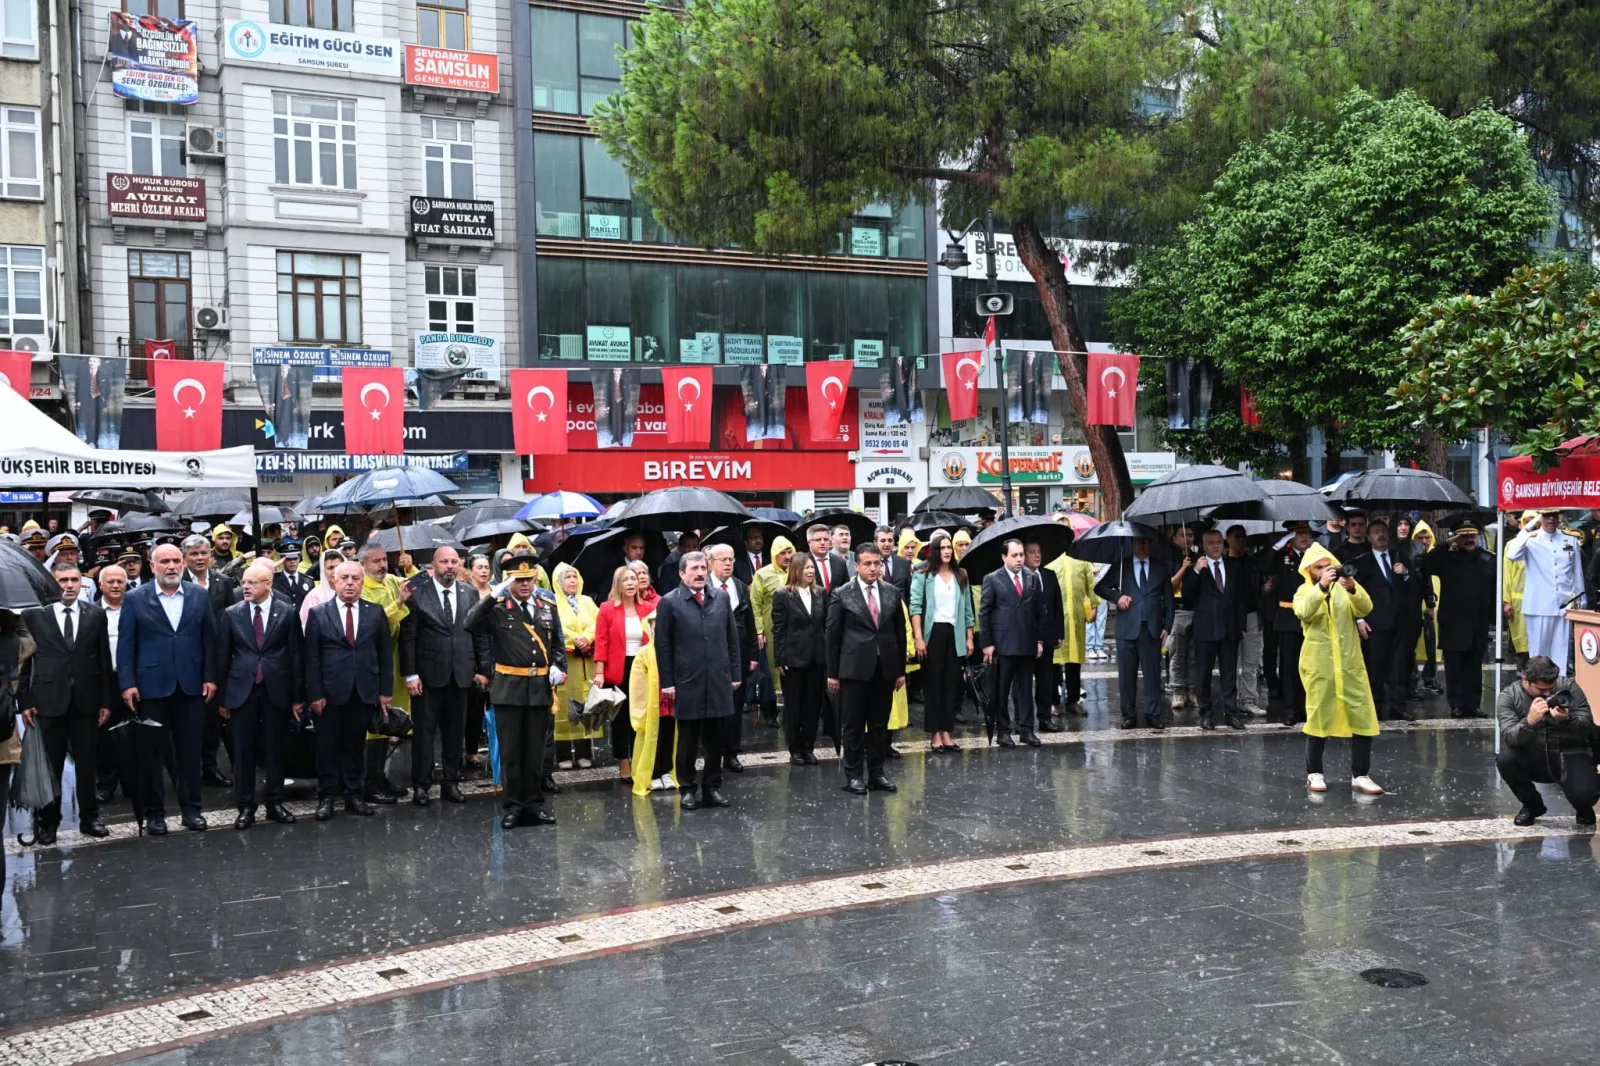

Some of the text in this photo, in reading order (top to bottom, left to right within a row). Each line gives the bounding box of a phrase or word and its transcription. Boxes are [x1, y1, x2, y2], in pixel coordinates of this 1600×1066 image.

[270, 32, 319, 49] EĞİTİM
[323, 38, 362, 54] GÜCÜ
[366, 45, 393, 57] SEN
[298, 58, 325, 66] SAMSUN
[415, 48, 469, 62] SEVDAMIZ
[414, 58, 489, 79] SAMSUN
[122, 77, 146, 86] SENDE
[414, 74, 489, 89] GENEL MERKEZİ
[164, 178, 198, 188] BÜROSU
[125, 193, 197, 204] AVUKAT
[432, 200, 455, 209] SARIKAYA
[457, 202, 473, 211] HUKUK
[111, 202, 205, 217] MEHRİ ÖZLEM AKALIN
[441, 213, 486, 223] AVUKAT
[414, 223, 493, 236] FUAT SARIKAYA
[976, 240, 1020, 257] BRE
[976, 258, 1025, 272] SGOR
[420, 333, 494, 347] PANDA BUNGALOV
[267, 349, 290, 359] SİNEM
[293, 350, 324, 360] ÖZKURT
[341, 351, 361, 360] SİNEM
[363, 352, 389, 362] ÖZKURT
[30, 387, 51, 396] /24
[75, 459, 156, 475] BELEDİYESİ
[265, 453, 296, 472] EV-İŞ
[298, 453, 351, 470] İNTERNET
[976, 451, 1063, 476] KOPERATİF
[261, 474, 293, 483] tivibu
[867, 467, 890, 483] AÇMAK
[1515, 483, 1540, 498] SAMSUN
[1542, 477, 1582, 500] BÜYÜKŞEHİR
